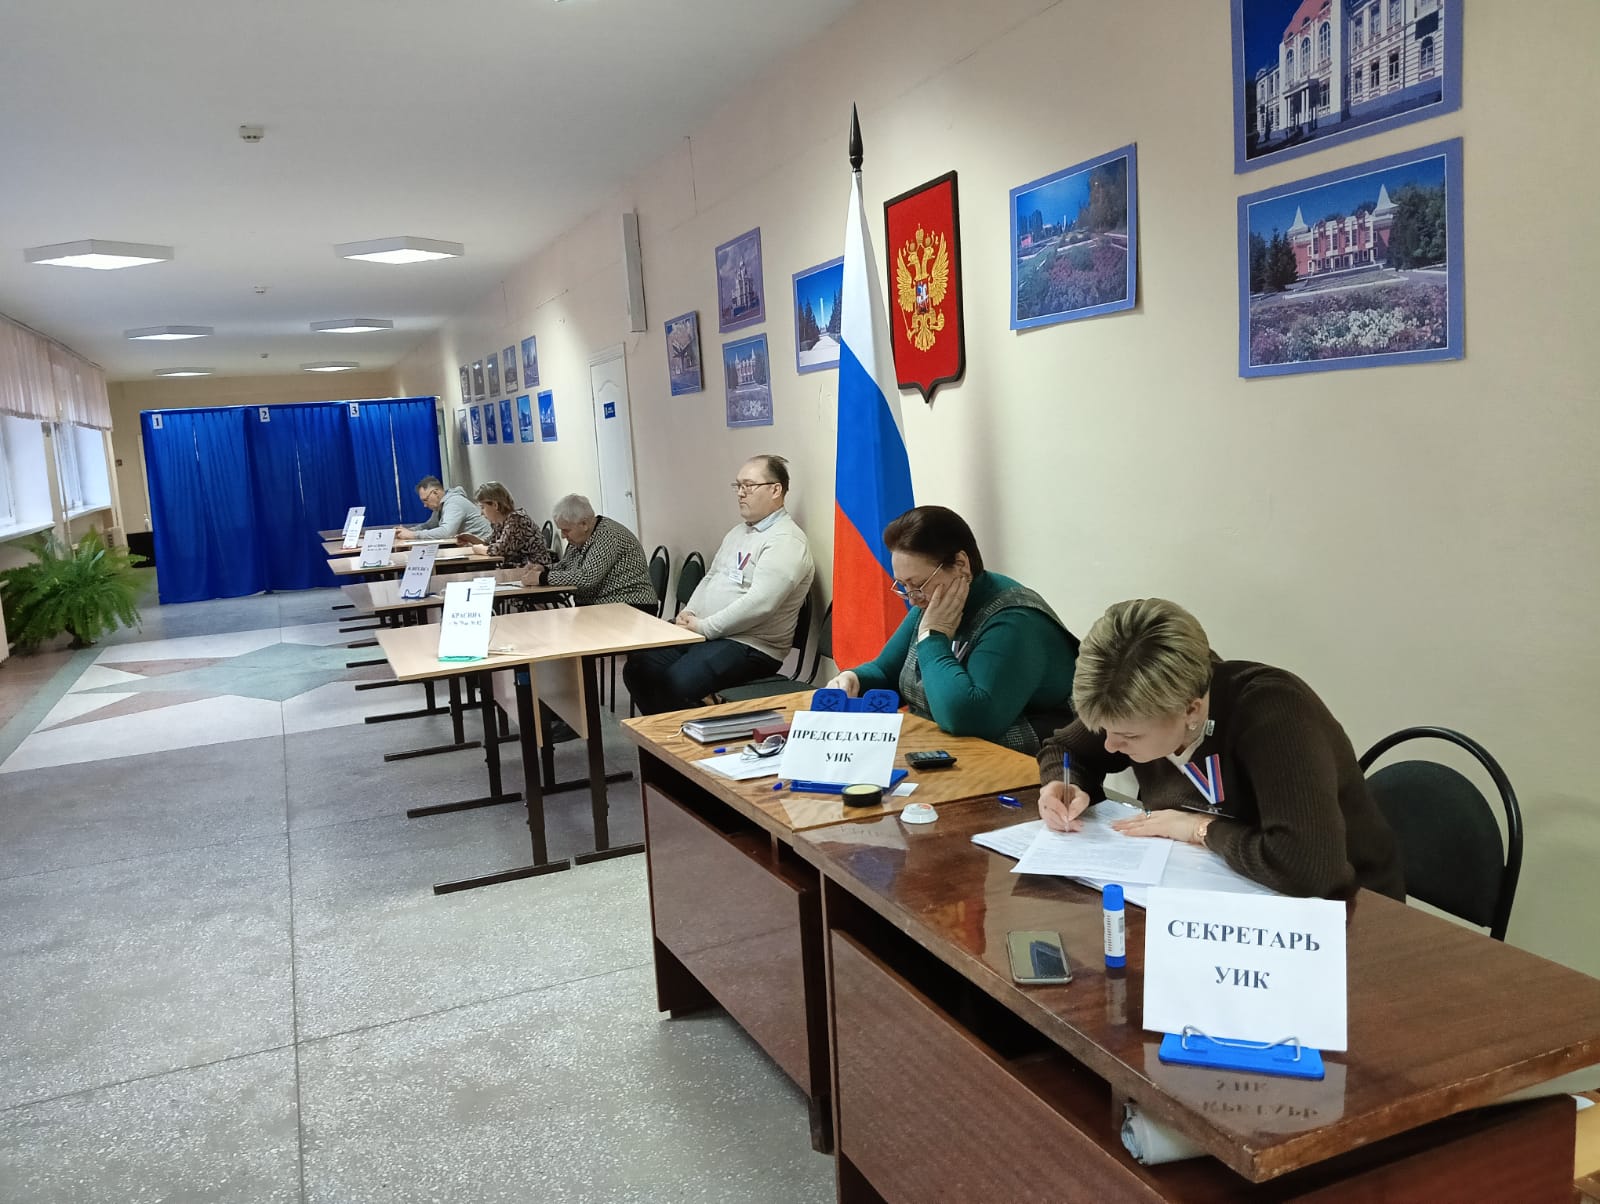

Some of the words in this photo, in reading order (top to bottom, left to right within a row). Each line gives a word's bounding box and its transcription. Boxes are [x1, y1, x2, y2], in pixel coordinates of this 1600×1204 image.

[261, 410, 268, 420] 2
[351, 406, 358, 415] 3
[154, 417, 160, 427] 1
[792, 729, 896, 742] ПРЕДСЕДАТЕЛЬ
[826, 752, 853, 762] УИК
[1167, 919, 1320, 951] СЕКРЕТАРЬ
[1215, 966, 1270, 989] УИК
